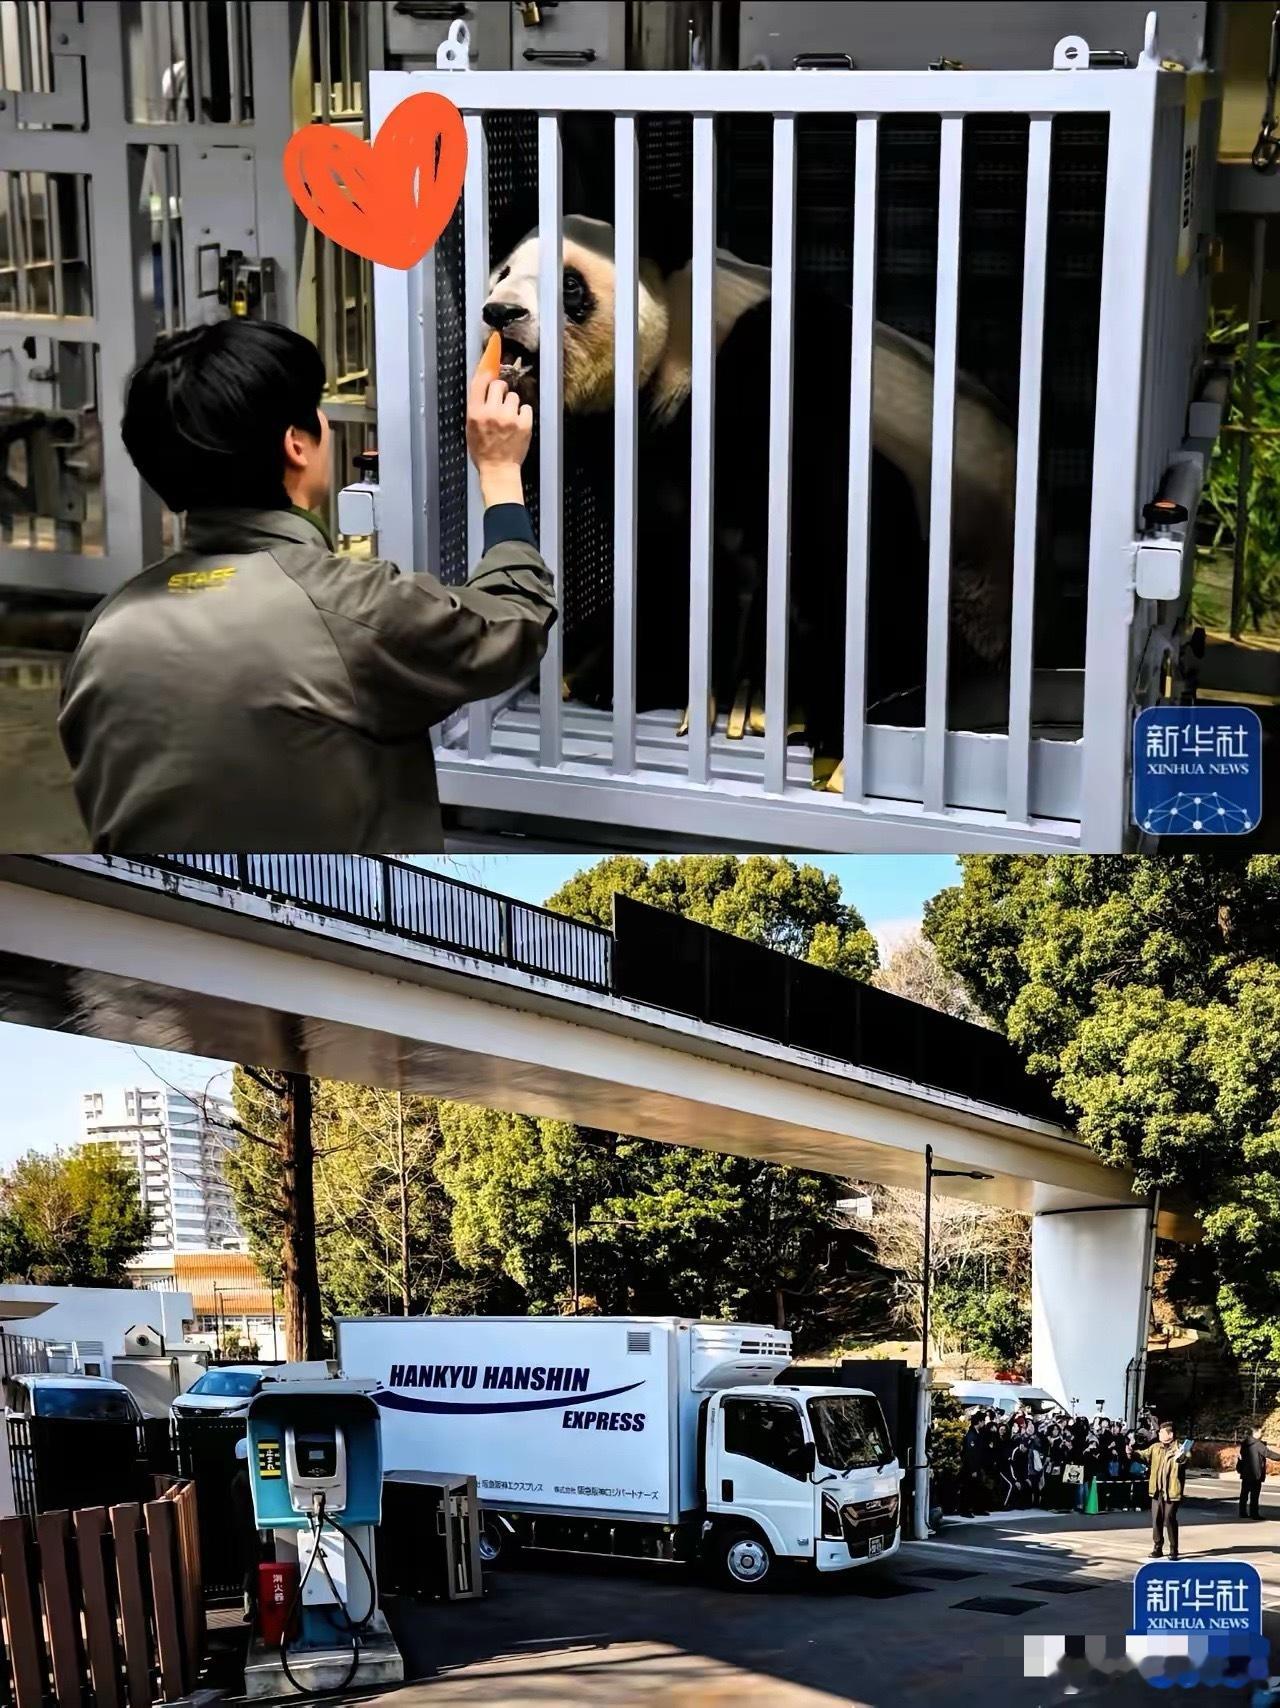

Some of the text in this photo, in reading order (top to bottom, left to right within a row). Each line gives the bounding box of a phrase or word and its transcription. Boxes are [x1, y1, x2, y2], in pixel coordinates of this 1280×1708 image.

[389, 1365, 590, 1392] HANKYU HANSHIN
[562, 1411, 646, 1432] EXPRESS
[265, 1449, 276, 1471] 止まれ
